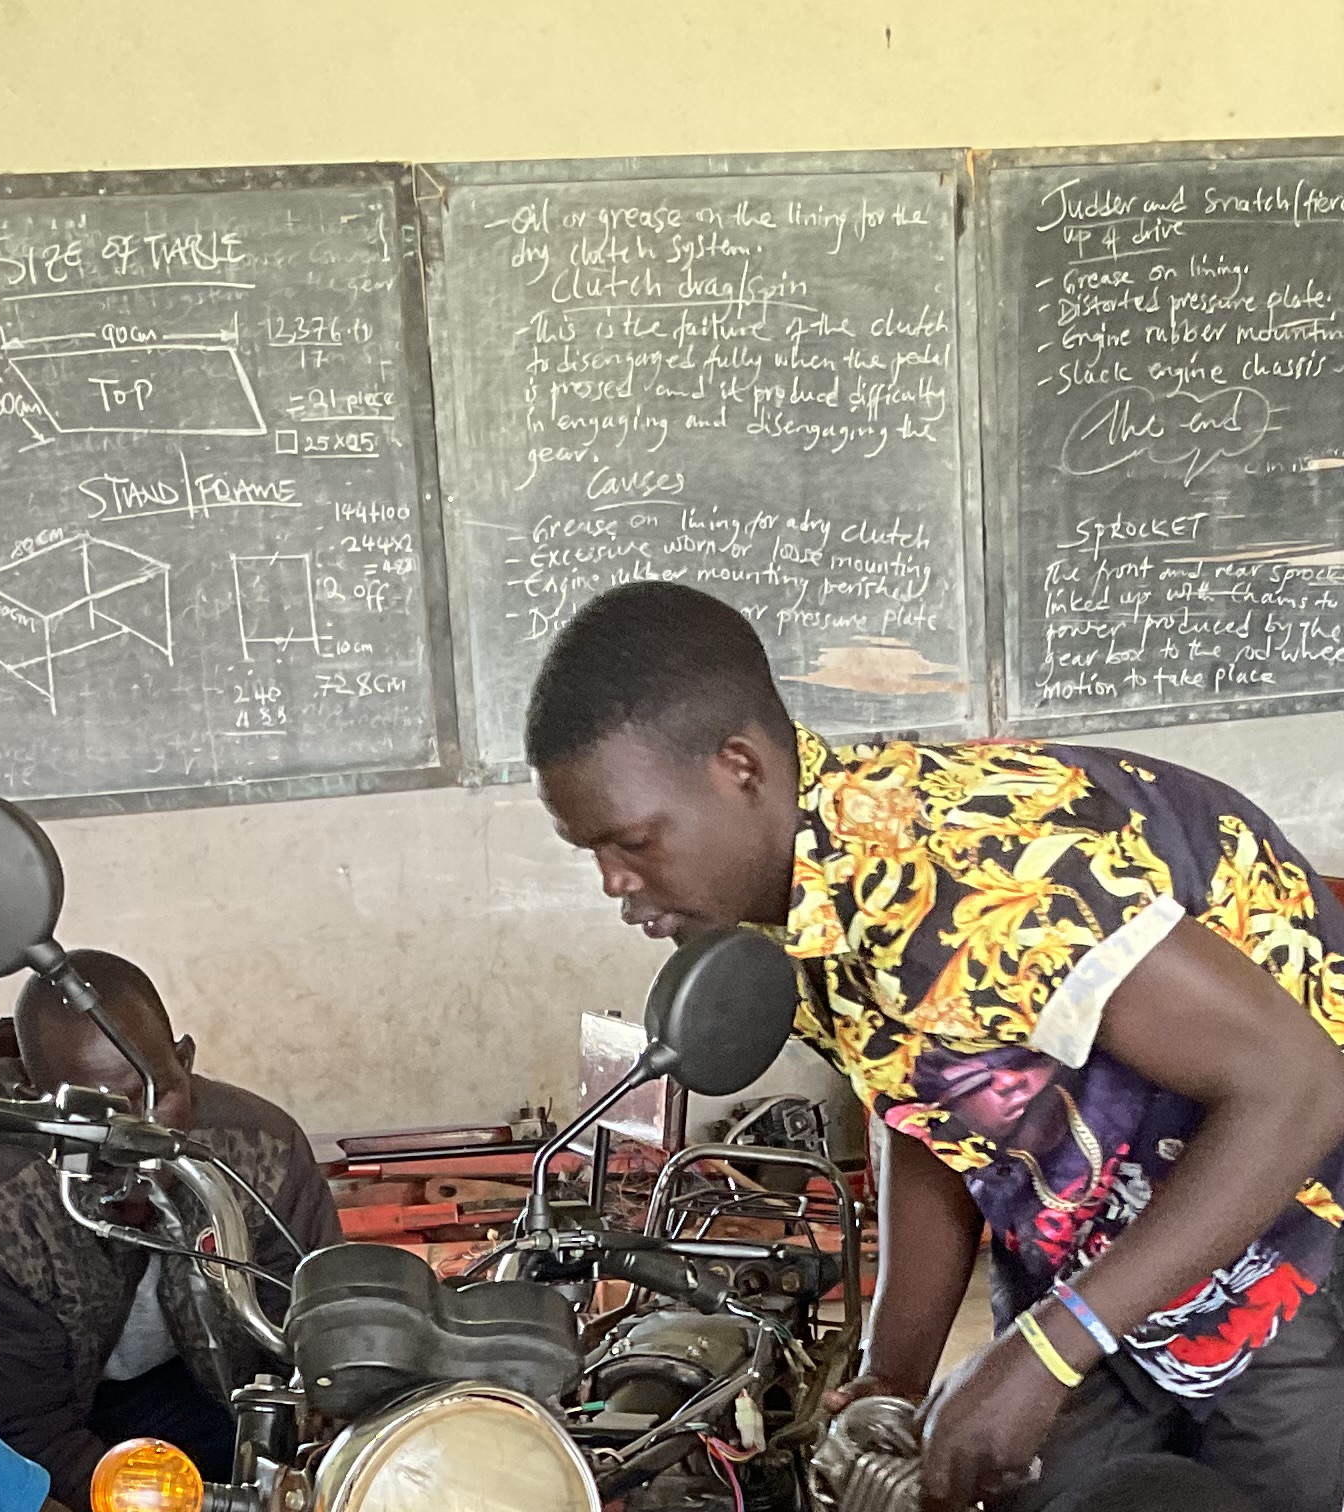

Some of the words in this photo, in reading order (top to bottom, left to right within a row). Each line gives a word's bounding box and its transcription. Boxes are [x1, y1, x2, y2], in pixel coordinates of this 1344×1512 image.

[512, 198, 549, 234] Oil
[563, 210, 586, 228] or
[599, 206, 682, 247] grease
[696, 207, 723, 229] on
[733, 200, 777, 227] the
[788, 200, 847, 255] lining
[854, 199, 885, 242] for
[891, 203, 929, 226] the
[1036, 178, 1137, 233] Judder
[1143, 184, 1188, 214] and
[144, 231, 246, 270] TABLE
[1131, 216, 1187, 245] drive
[511, 238, 549, 286] dry
[570, 236, 656, 266] clutch
[1063, 268, 1135, 294] Grease
[1148, 265, 1178, 282] on
[551, 266, 662, 303] Clutch
[1057, 286, 1162, 327] Distorted
[1169, 291, 1259, 328] pressure
[529, 309, 576, 343] This
[596, 306, 614, 339] is
[623, 309, 668, 338] the
[810, 312, 856, 337] the
[871, 304, 949, 338] clutch
[1061, 321, 1133, 368] Engine
[1144, 318, 1228, 346] rubber
[525, 346, 550, 376] to
[556, 345, 696, 392] disengaged
[702, 344, 762, 390] fully
[774, 346, 836, 371] when
[843, 347, 887, 369] the
[890, 344, 950, 386] pedal
[1056, 359, 1134, 396] Slack
[1148, 351, 1228, 398] engine
[1242, 349, 1327, 381] chassis
[524, 377, 538, 403] is
[550, 380, 633, 421] pressed
[655, 375, 705, 400] and
[719, 376, 744, 403] it
[1080, 399, 1165, 446] The
[1179, 390, 1243, 433] end
[526, 406, 545, 433] in
[556, 405, 669, 453] engaging
[685, 405, 727, 430] and
[746, 406, 888, 459] disengaging
[895, 413, 937, 442] the
[586, 466, 685, 500] Causes
[532, 515, 618, 544] Grease
[681, 505, 740, 551] lining
[744, 510, 780, 540] for
[524, 566, 600, 618] Engine
[697, 561, 809, 612] mounting
[817, 575, 914, 607] perished
[663, 534, 717, 555] worn
[730, 543, 753, 559] or
[830, 551, 932, 599] mounting
[1044, 557, 1081, 592] The
[1091, 555, 1156, 597] front
[1158, 560, 1203, 581] and
[1214, 563, 1264, 578] rear
[740, 604, 769, 621] or
[776, 608, 868, 637] pressure
[882, 602, 938, 636] plate
[1045, 585, 1110, 619] linked
[1120, 590, 1153, 625] up
[1166, 581, 1215, 602] with
[1314, 590, 1339, 610] to
[1045, 622, 1127, 652] power
[1140, 606, 1254, 651] produced
[1263, 613, 1293, 651] by
[1036, 648, 1099, 688] gear
[1105, 638, 1146, 665] box
[1159, 637, 1179, 659] to
[1187, 637, 1222, 661] the
[1123, 668, 1147, 690] to
[1153, 667, 1205, 695] take
[1214, 662, 1277, 694] place
